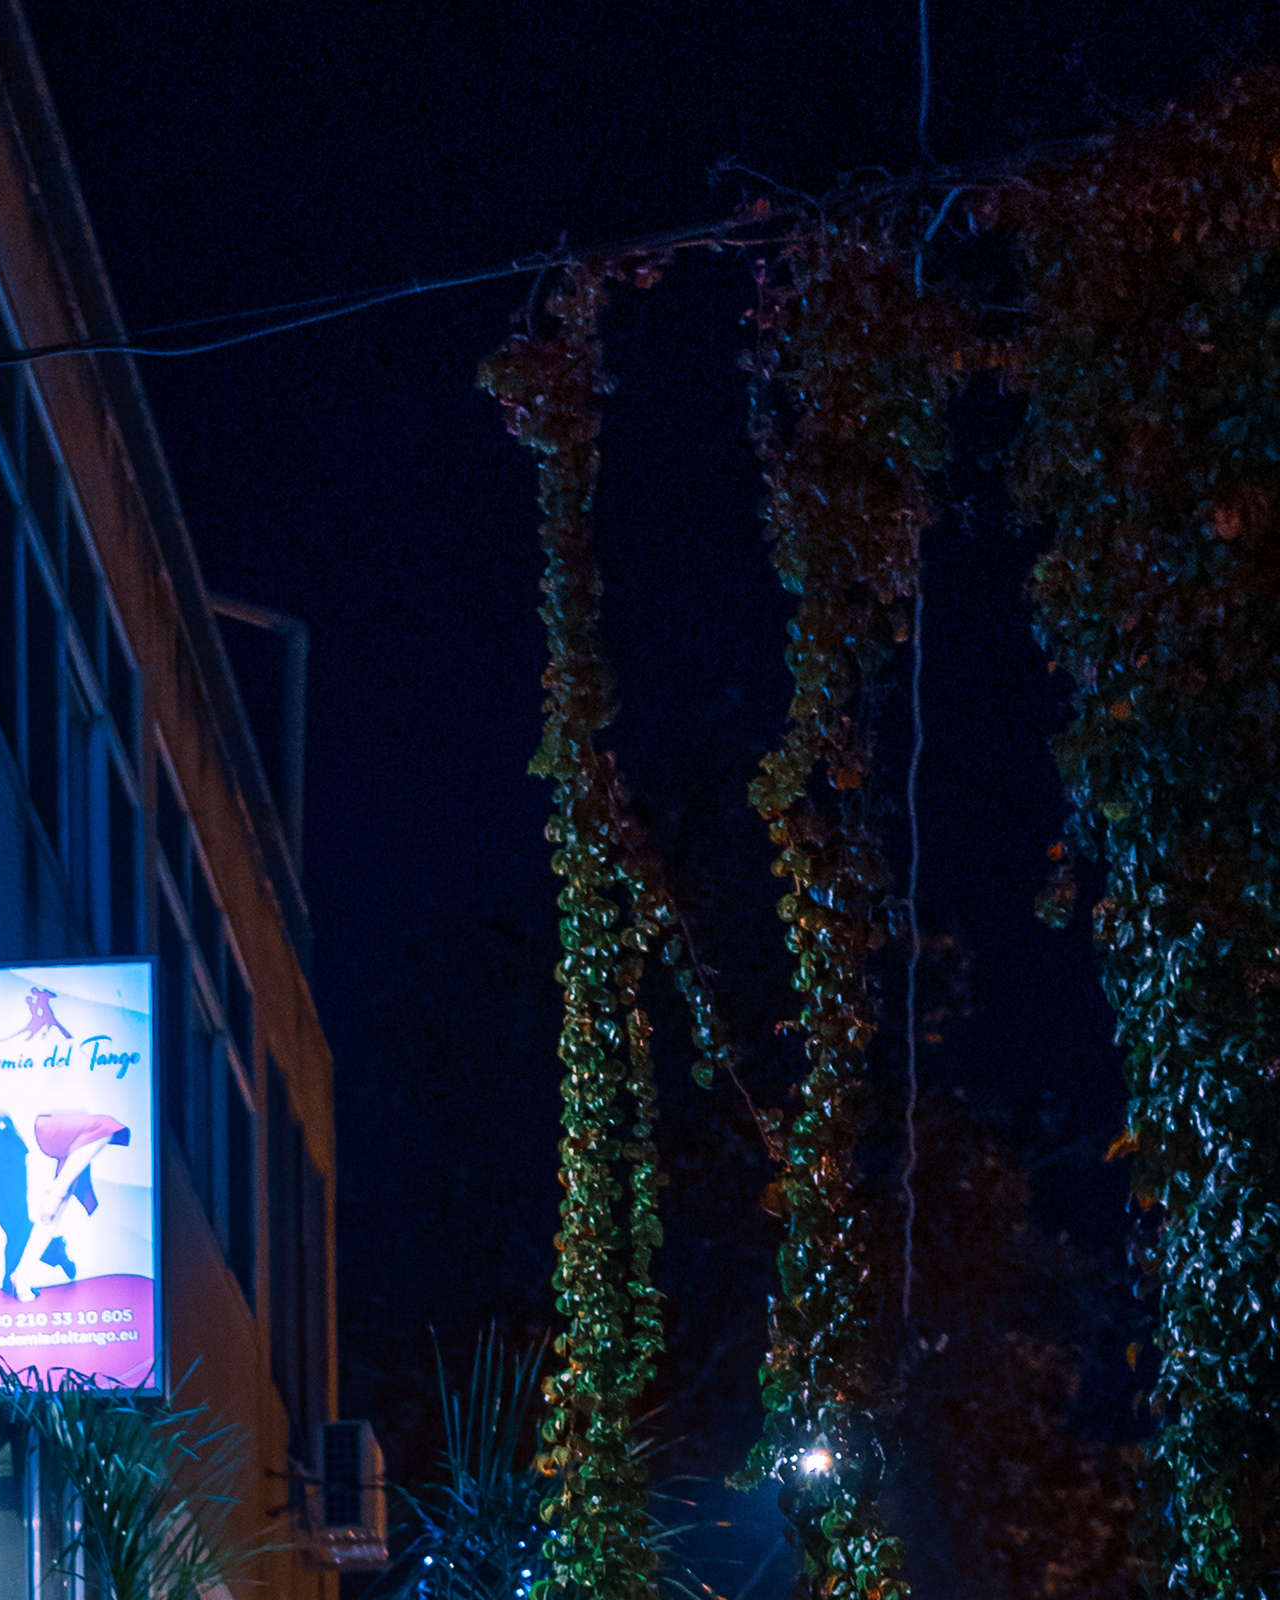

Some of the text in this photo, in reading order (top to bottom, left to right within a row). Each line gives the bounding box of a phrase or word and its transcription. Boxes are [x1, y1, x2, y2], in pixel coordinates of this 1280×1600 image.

[43, 1044, 72, 1069] del
[80, 1034, 141, 1080] Tango
[15, 1312, 49, 1328] 210
[52, 1311, 74, 1326] 33
[76, 1310, 98, 1325] 10
[101, 1308, 133, 1324] 605
